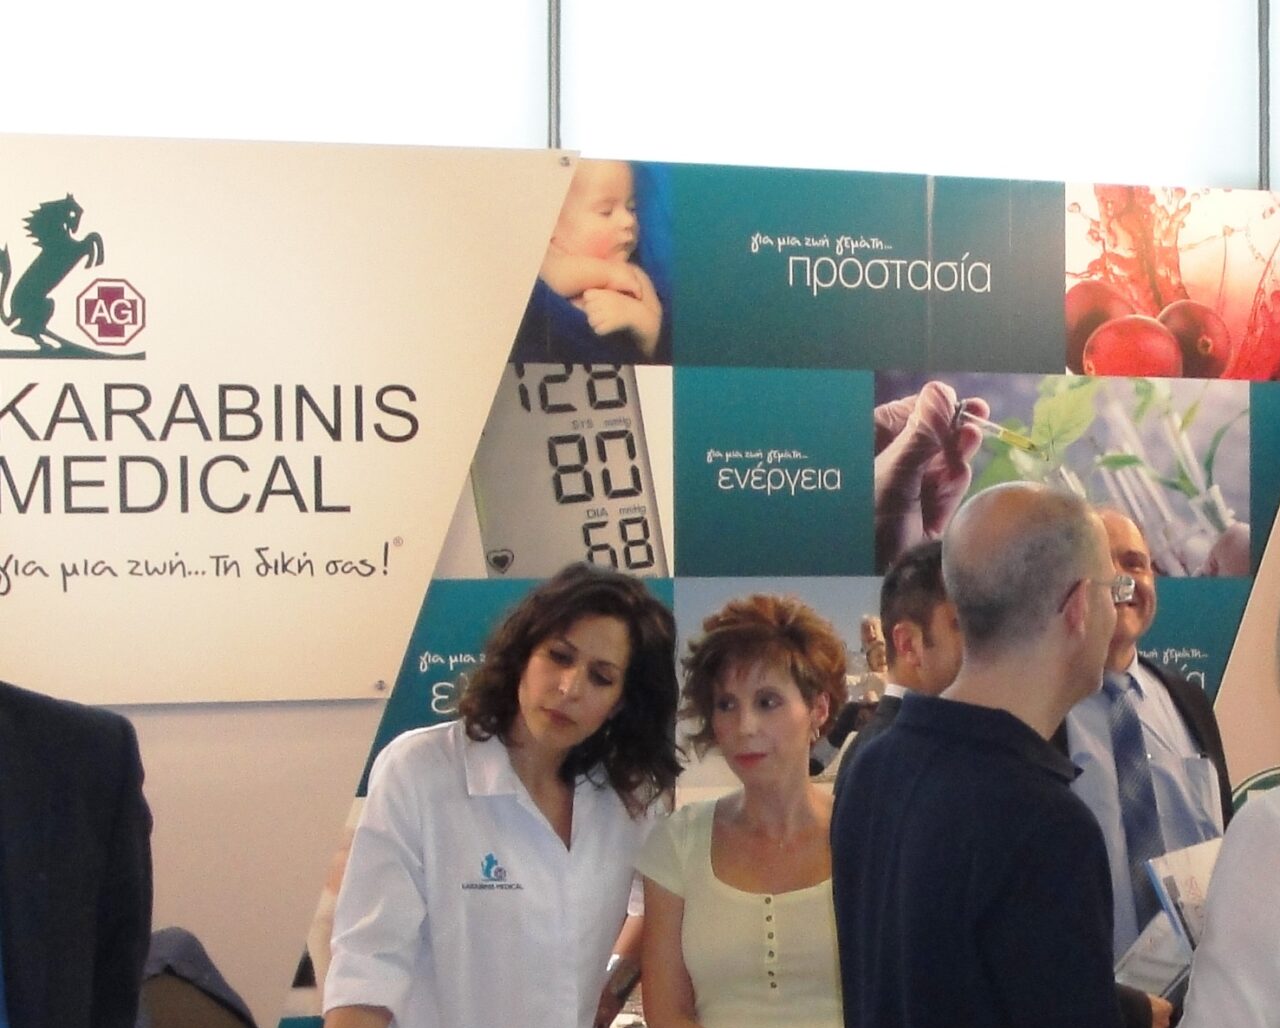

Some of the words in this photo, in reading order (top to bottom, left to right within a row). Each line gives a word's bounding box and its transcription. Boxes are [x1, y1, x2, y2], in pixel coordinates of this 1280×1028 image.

[751, 233, 774, 252] για
[778, 237, 800, 252] μια
[789, 252, 991, 297] προστασία
[91, 300, 133, 324] AG
[548, 430, 642, 504] 80
[718, 461, 841, 496] ενέργεια
[0, 456, 350, 514] MEDICAL
[586, 508, 609, 519] DIA
[61, 559, 118, 592] μια
[255, 547, 314, 578] δική
[326, 542, 389, 577] σας!
[420, 651, 446, 673] για
[449, 653, 476, 671] μια
